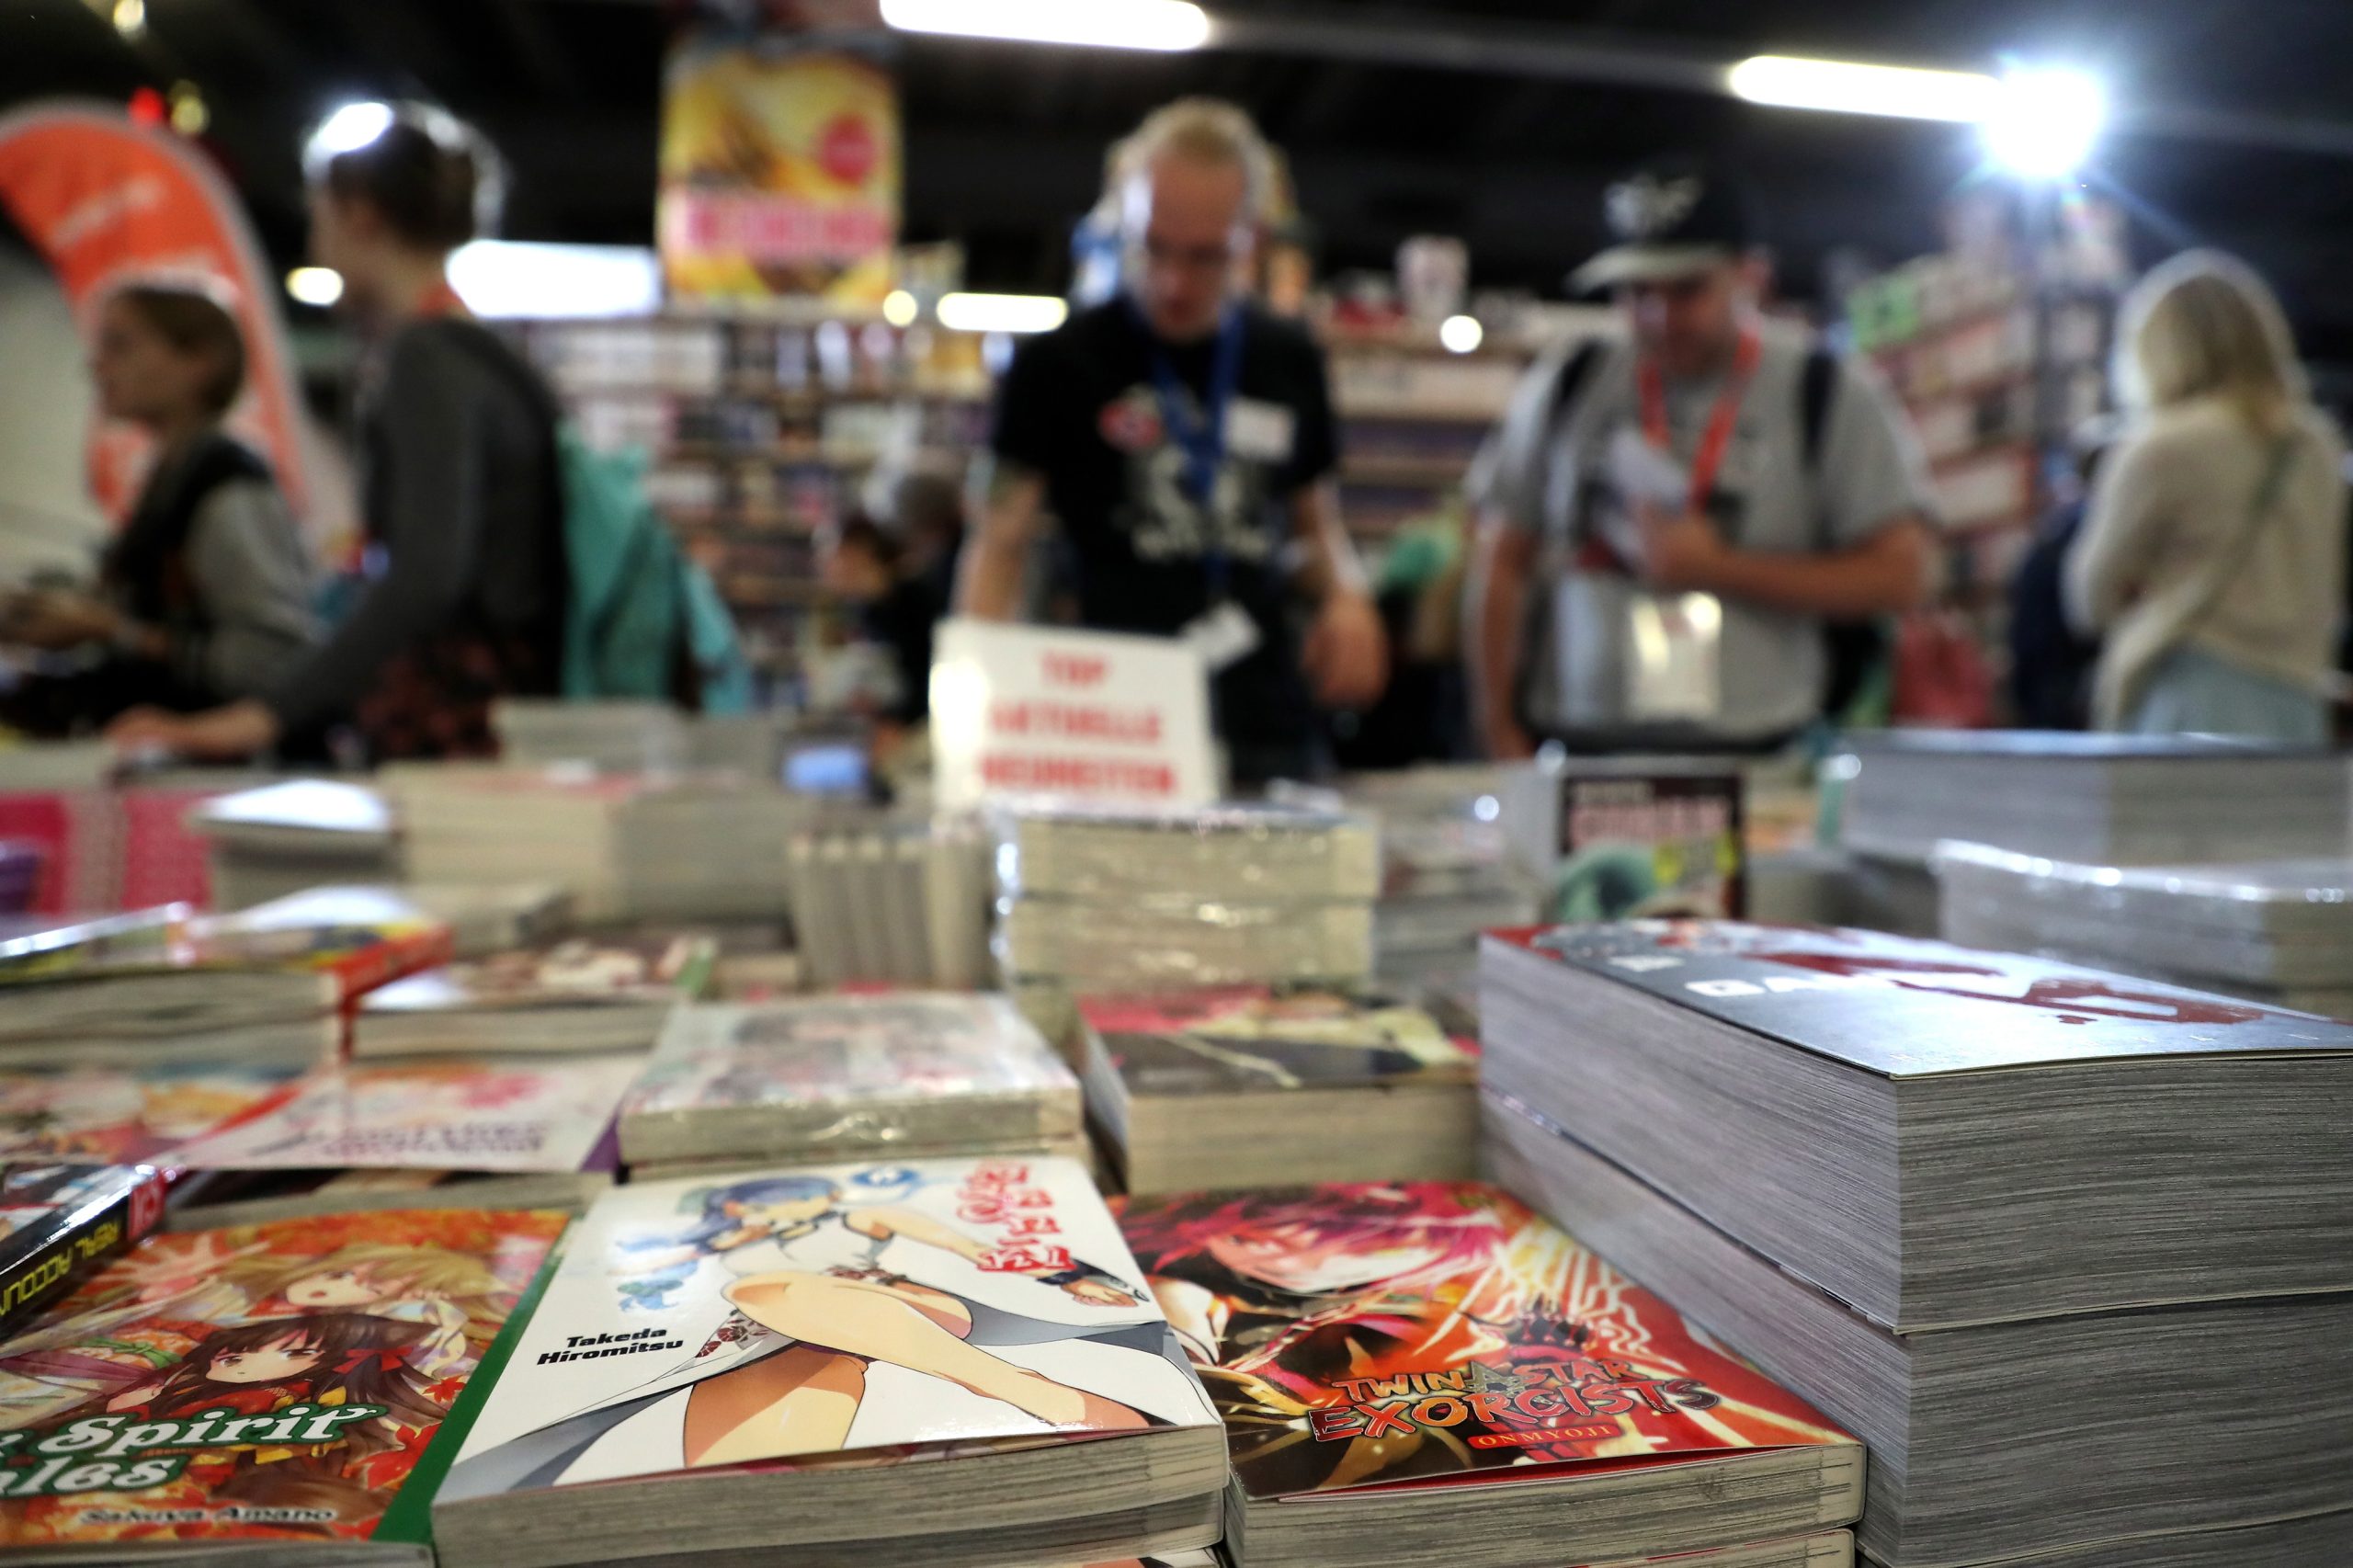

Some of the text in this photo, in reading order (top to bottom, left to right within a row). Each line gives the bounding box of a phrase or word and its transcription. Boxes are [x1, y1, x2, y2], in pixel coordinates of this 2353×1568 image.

[536, 1339, 684, 1366] Hiromitsu
[566, 1327, 668, 1348] Takeda
[1331, 1358, 1641, 1403] TWIN STAR
[1306, 1379, 1720, 1442] EXORCISTS
[37, 1407, 378, 1458] Spirit
[1478, 1424, 1612, 1448] ONMYOJI
